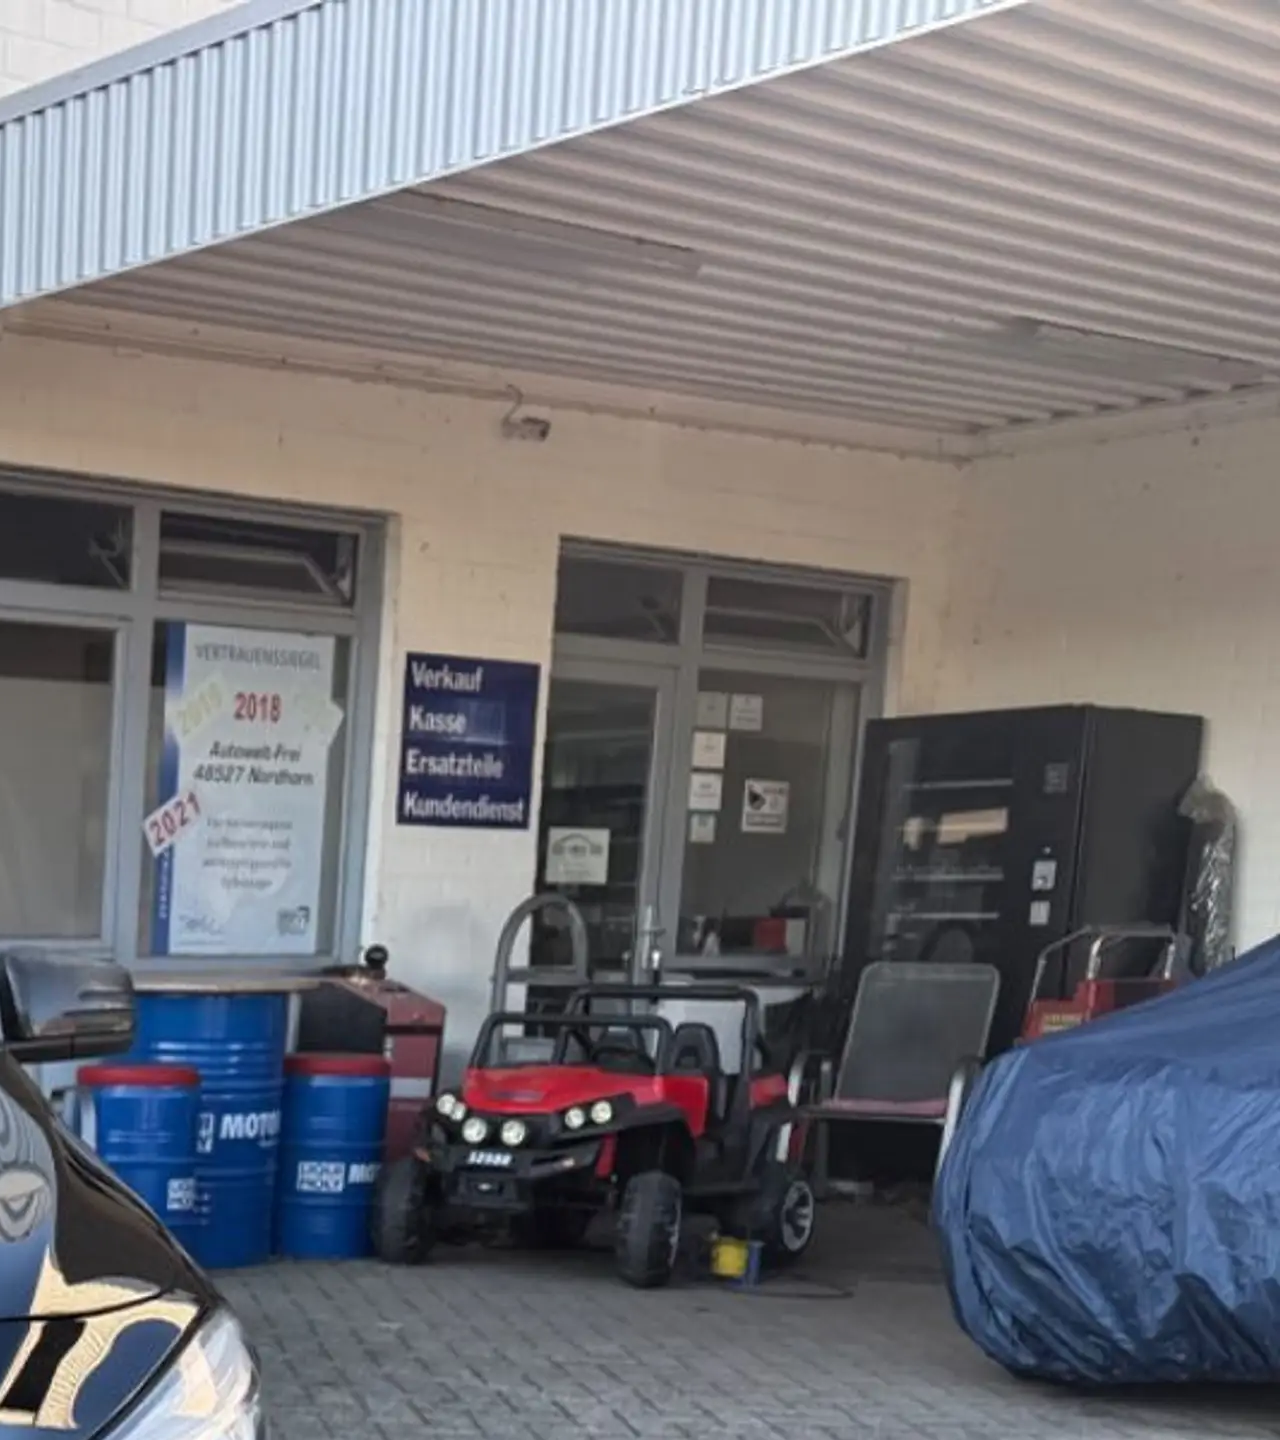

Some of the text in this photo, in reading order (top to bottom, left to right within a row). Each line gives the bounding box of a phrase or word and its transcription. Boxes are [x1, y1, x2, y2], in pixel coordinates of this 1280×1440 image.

[411, 660, 484, 692] Verkauf
[234, 691, 283, 723] 2018
[409, 704, 467, 734] Kasse
[406, 748, 505, 779] Ersatzteile
[149, 791, 201, 847] 2021
[403, 791, 524, 823] Kundendienst
